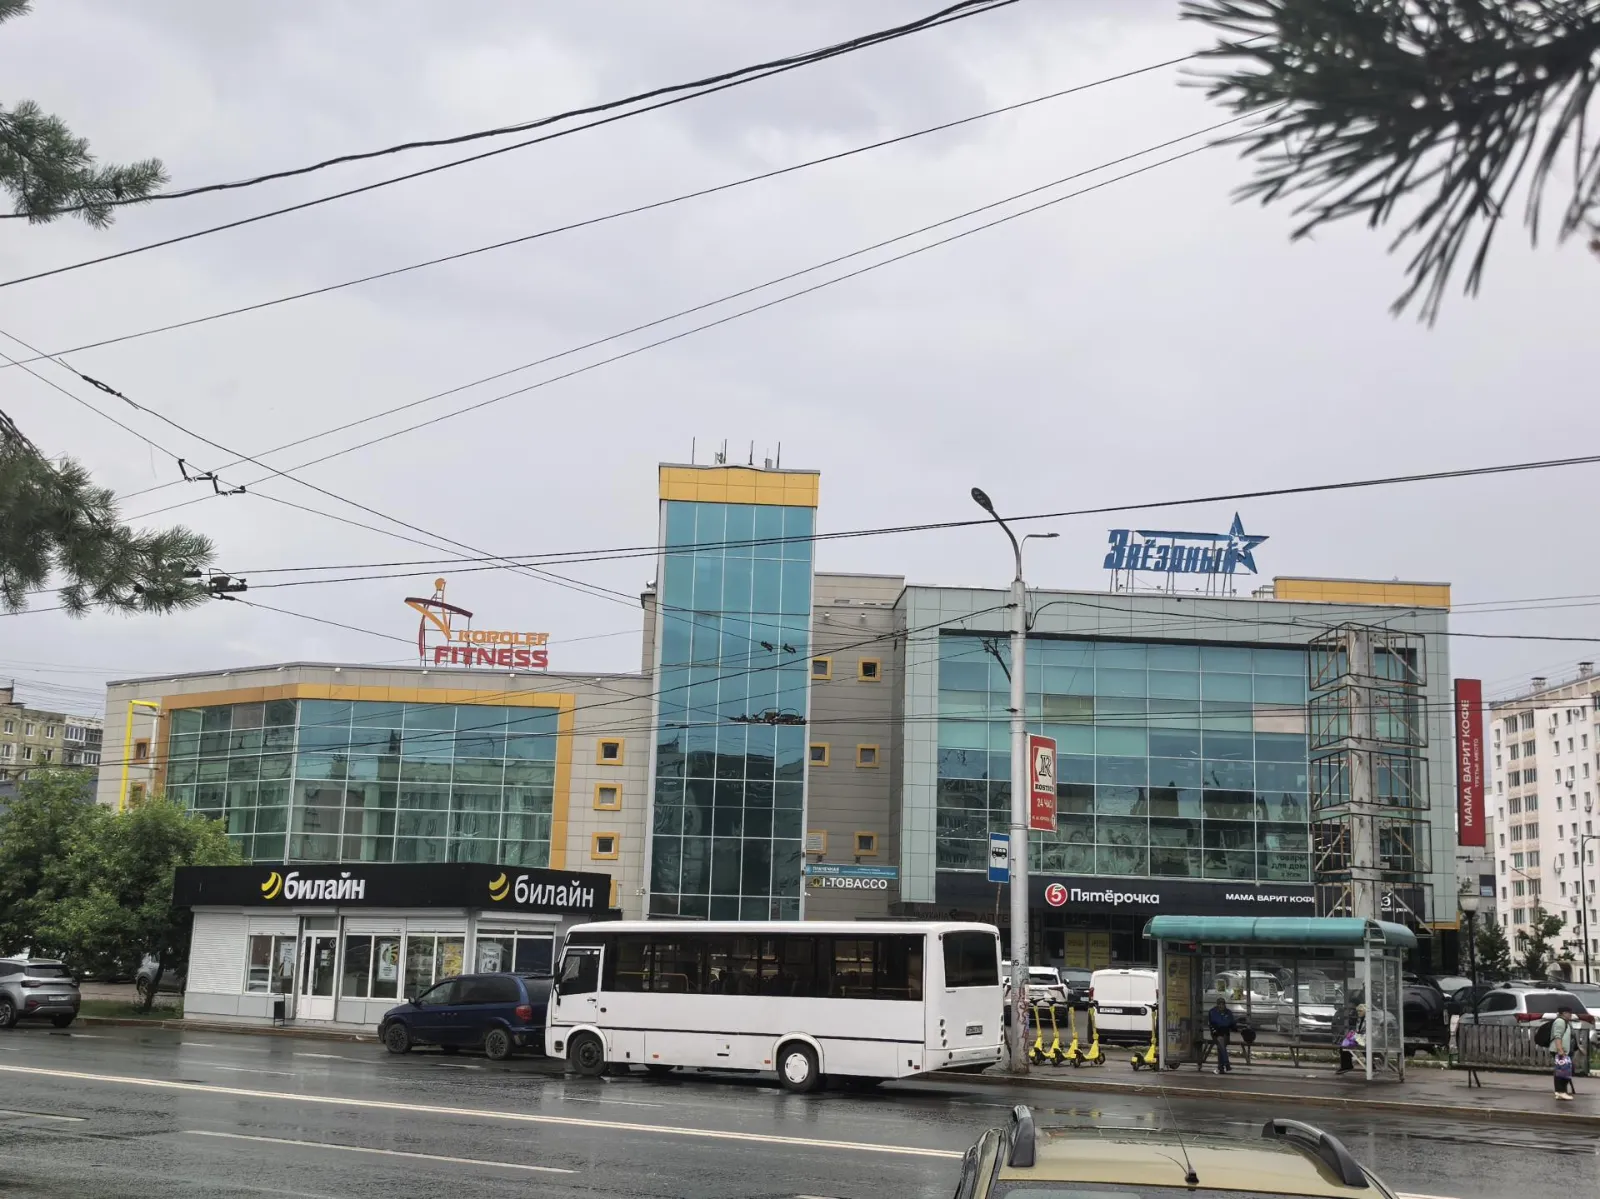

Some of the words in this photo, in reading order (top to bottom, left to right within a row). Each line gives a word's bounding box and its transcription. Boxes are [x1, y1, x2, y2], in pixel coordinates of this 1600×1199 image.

[434, 646, 548, 667] FITNESS
[1461, 699, 1470, 738] КОФЕ
[1462, 740, 1472, 782] ВАРИТ
[1464, 786, 1473, 827] МАМА
[283, 871, 366, 901] билайн
[514, 874, 595, 908] билайн
[822, 877, 888, 890] I-TOBACCO
[1070, 888, 1160, 906] Пятёрочка
[1225, 893, 1255, 902] МАМА
[1257, 894, 1288, 903] ВАРИТ
